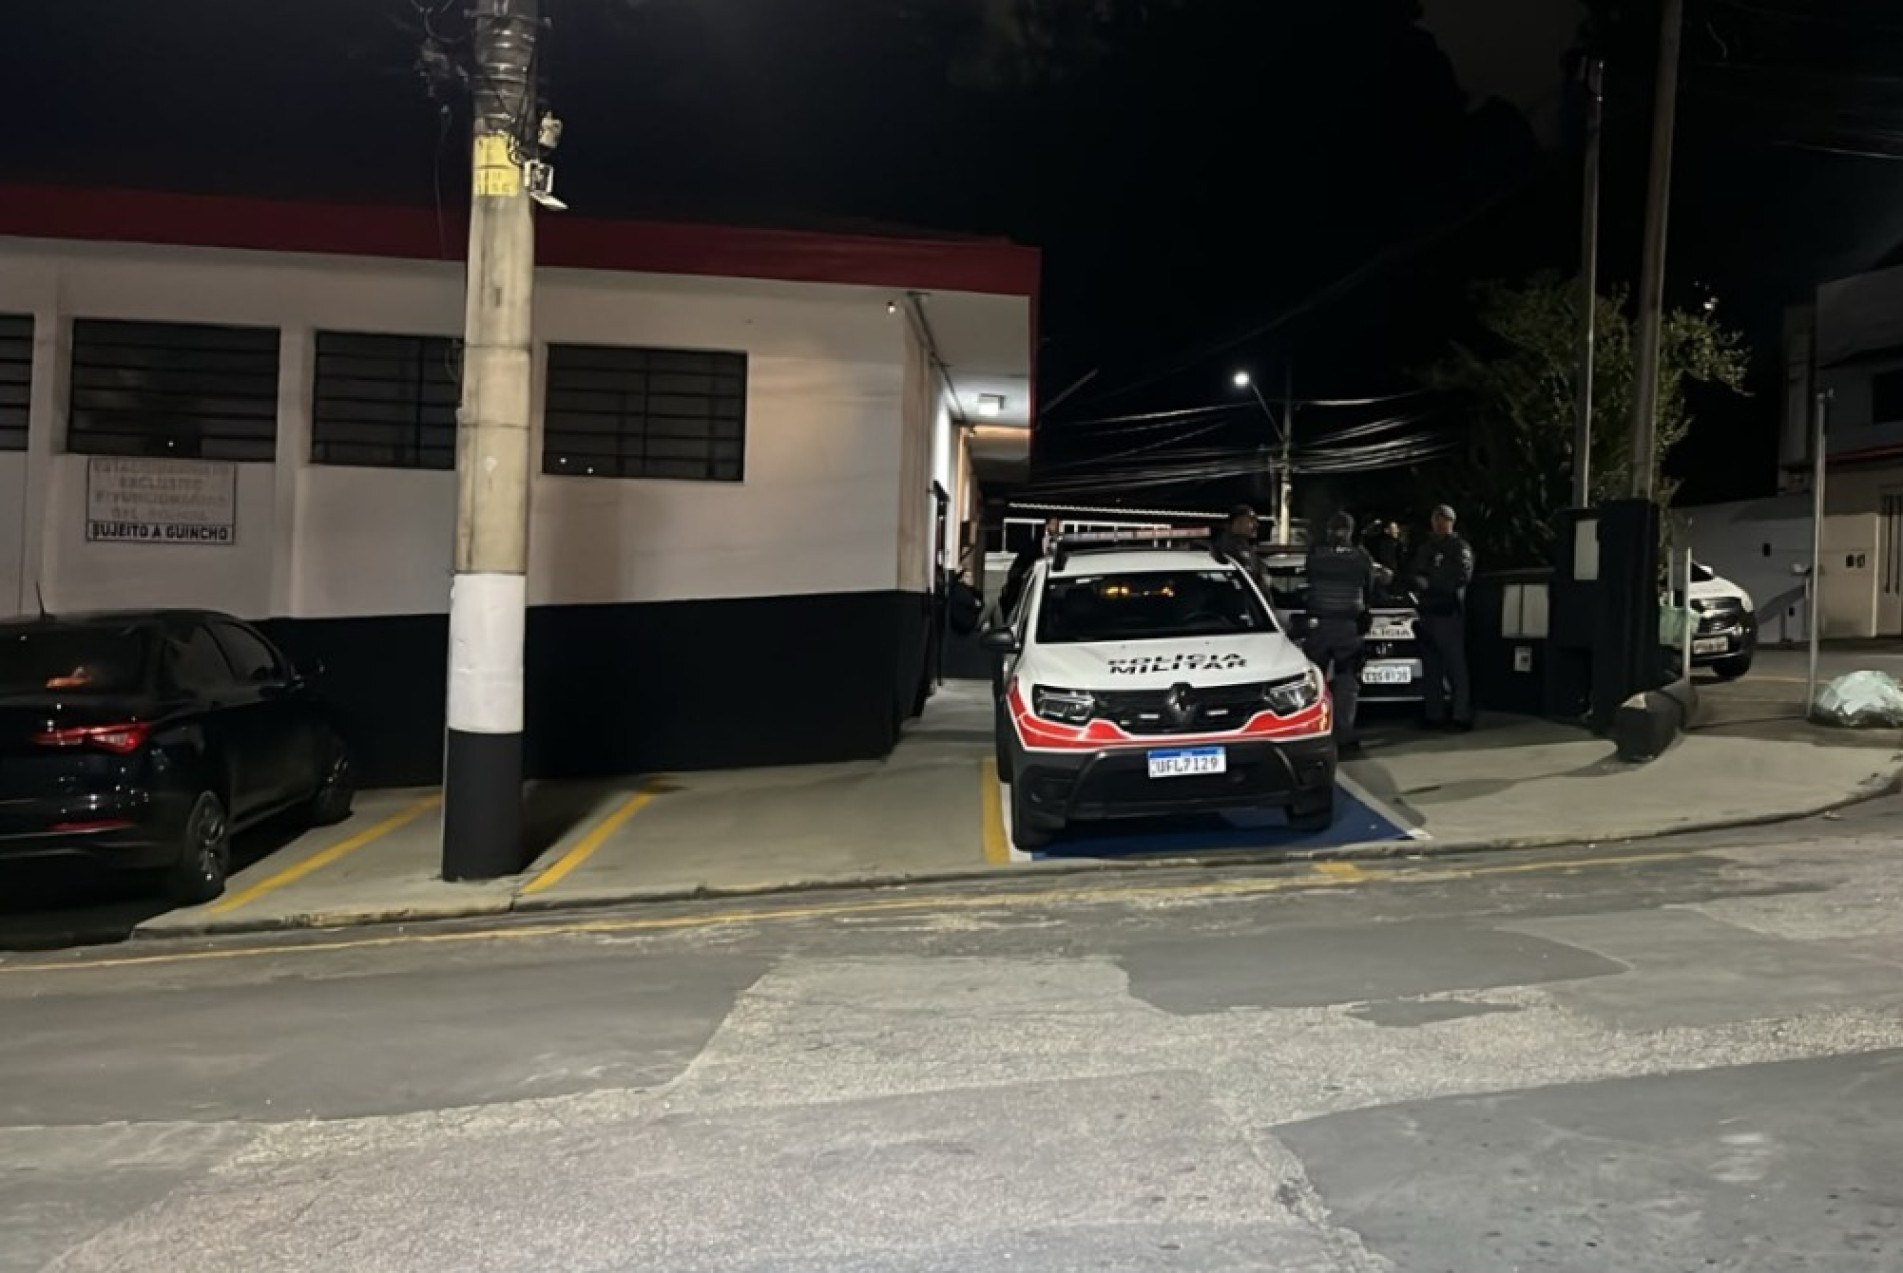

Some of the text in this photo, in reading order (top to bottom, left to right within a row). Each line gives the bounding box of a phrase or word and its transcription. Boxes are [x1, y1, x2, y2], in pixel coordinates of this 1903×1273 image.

[92, 522, 229, 541] SUJEITO A GUINCHO
[1110, 658, 1248, 675] MILITAR
